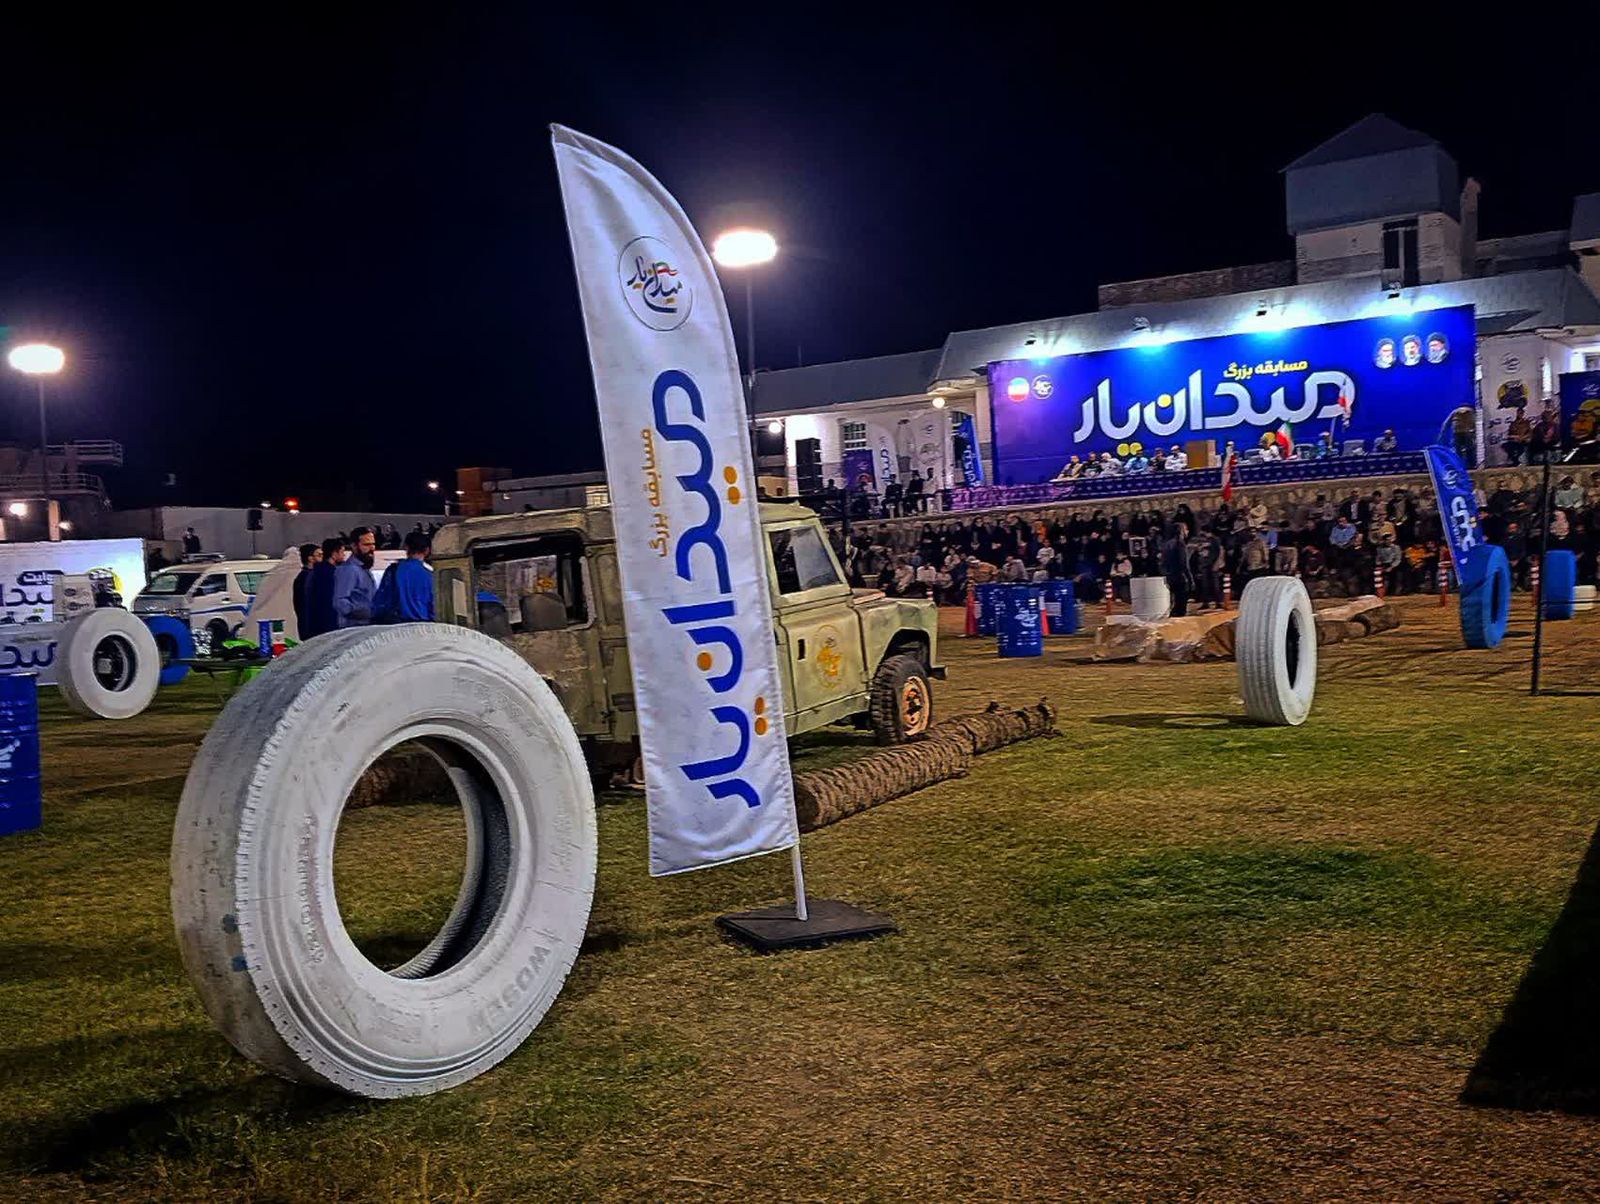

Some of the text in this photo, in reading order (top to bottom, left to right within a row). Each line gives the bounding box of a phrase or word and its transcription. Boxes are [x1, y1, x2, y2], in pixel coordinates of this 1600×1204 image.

[1223, 359, 1308, 381] مسابقه بزرگ
[641, 428, 671, 557] مسابقه بزرگ
